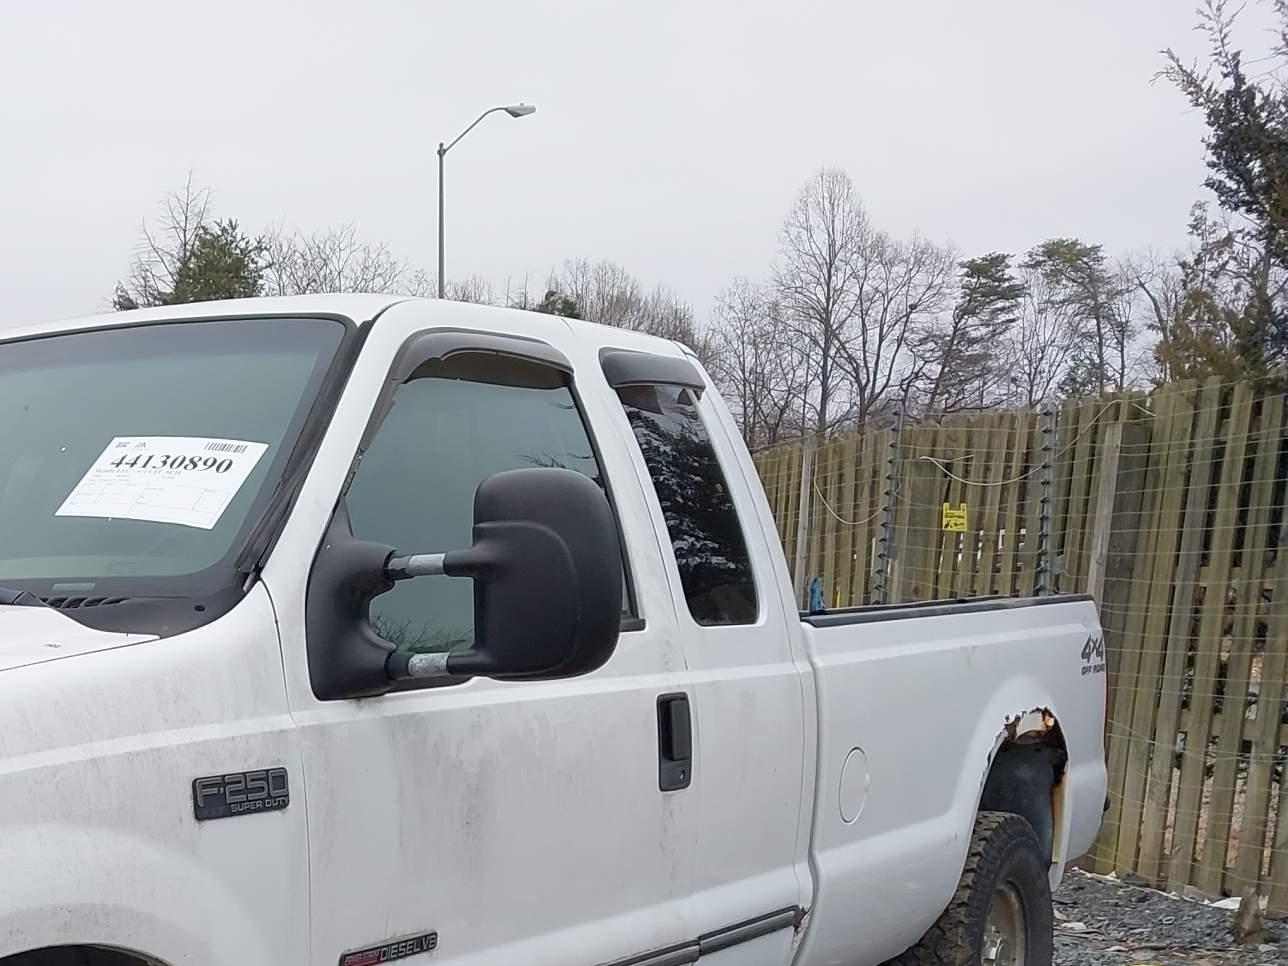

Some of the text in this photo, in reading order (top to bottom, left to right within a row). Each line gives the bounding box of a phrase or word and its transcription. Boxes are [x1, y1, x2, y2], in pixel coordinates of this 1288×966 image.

[110, 454, 234, 474] 44130890
[230, 796, 289, 813] SUPER DUTY
[379, 940, 421, 961] DIESEL
[422, 935, 437, 950] V8
